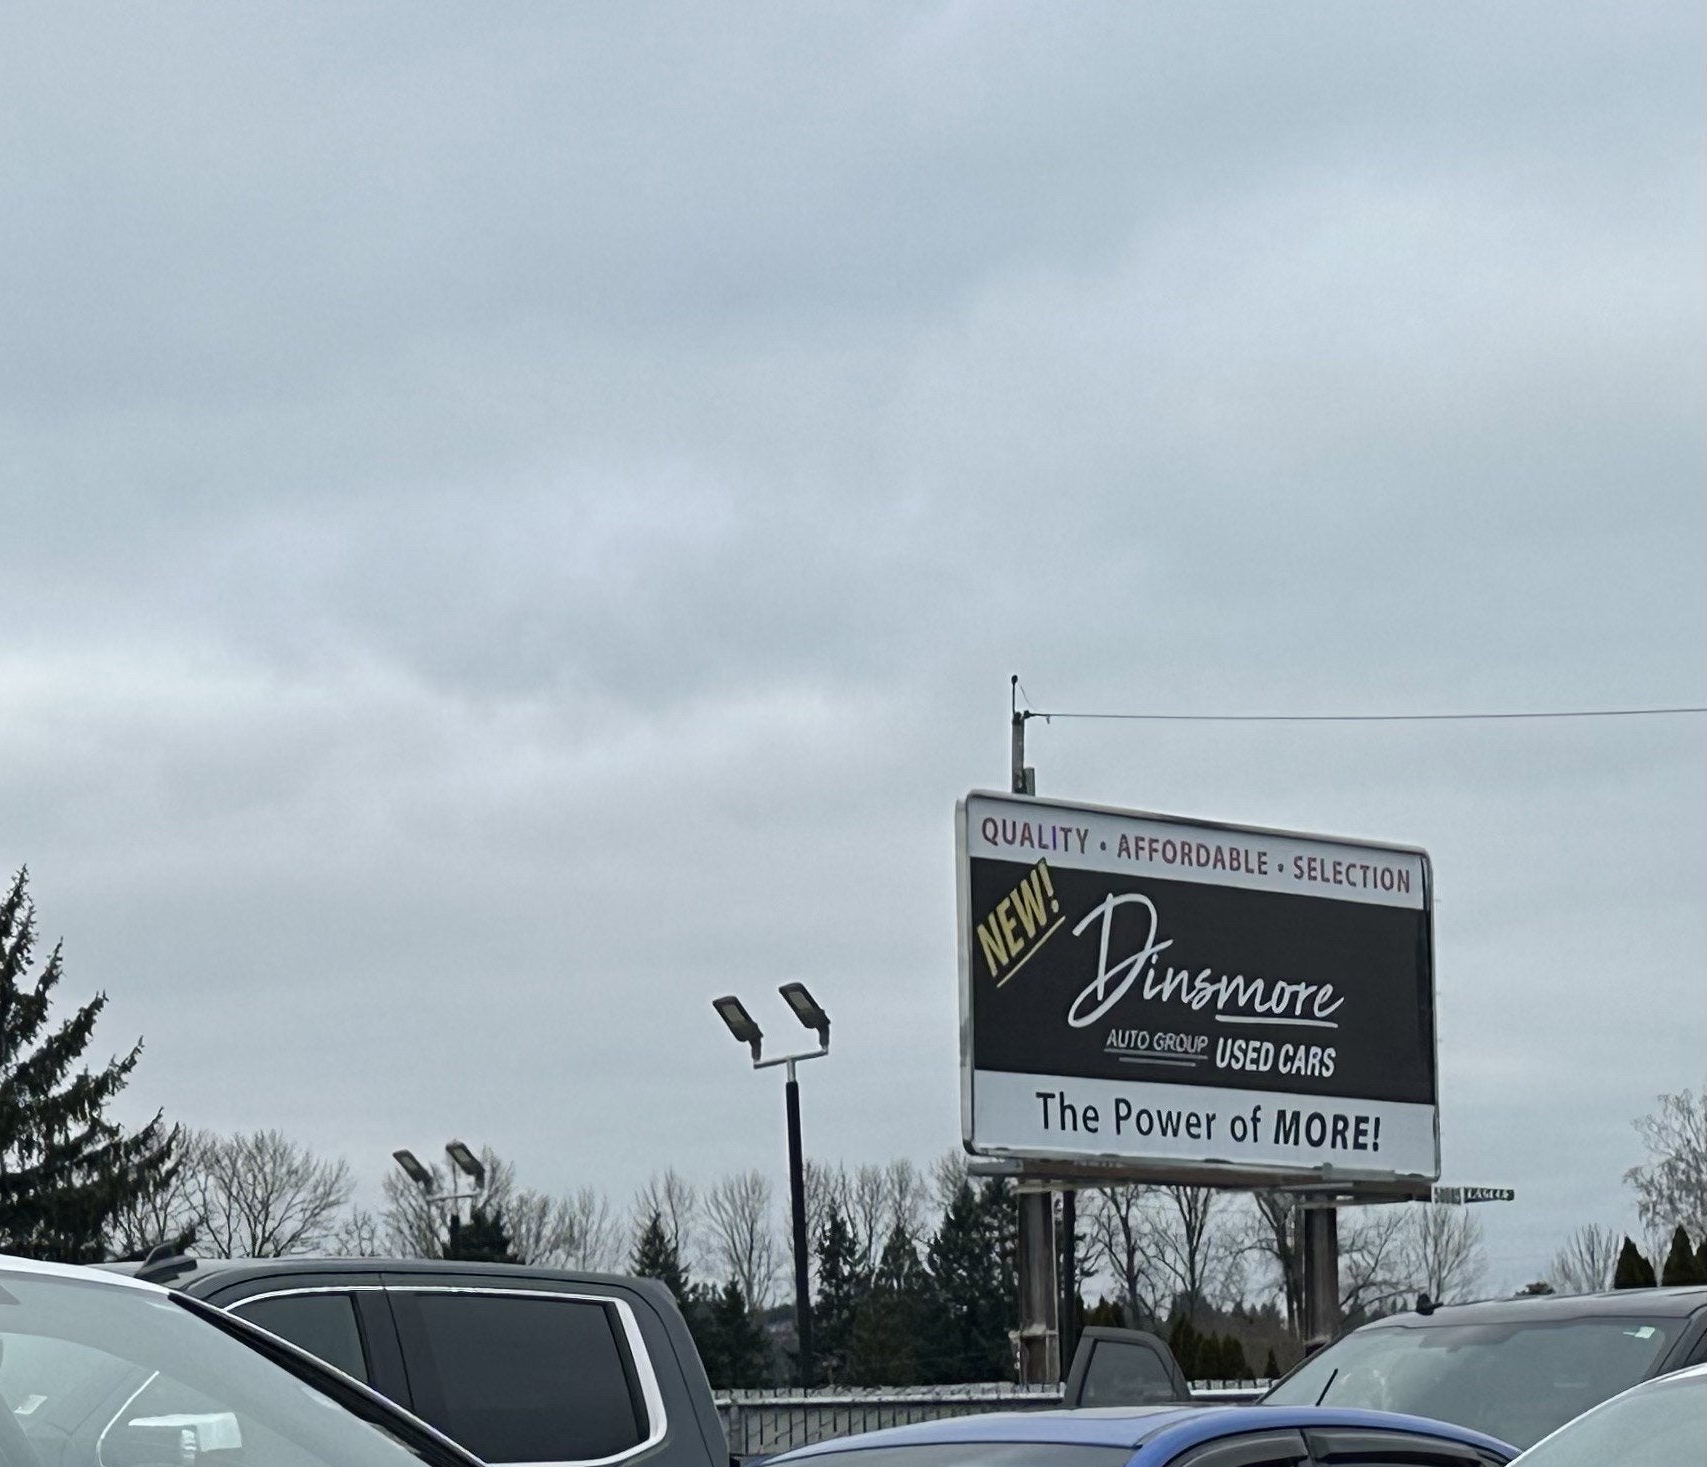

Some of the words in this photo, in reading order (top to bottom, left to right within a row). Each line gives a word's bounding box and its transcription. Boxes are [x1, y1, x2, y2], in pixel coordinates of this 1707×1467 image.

[981, 817, 1089, 854] QUALITY
[1117, 834, 1268, 876] AFFORDABLE
[1293, 855, 1411, 894] SELECTION
[976, 856, 1060, 977] NEW!
[1068, 893, 1344, 1028] Dinsmore
[1106, 1029, 1150, 1051] AUTO
[1153, 1033, 1209, 1055] GROUP
[1216, 1037, 1274, 1071] USED
[1278, 1043, 1337, 1078] CARS
[1036, 1091, 1100, 1135] The
[1115, 1098, 1215, 1141] Power
[1230, 1105, 1262, 1144] of
[1273, 1109, 1382, 1153] MORE!
